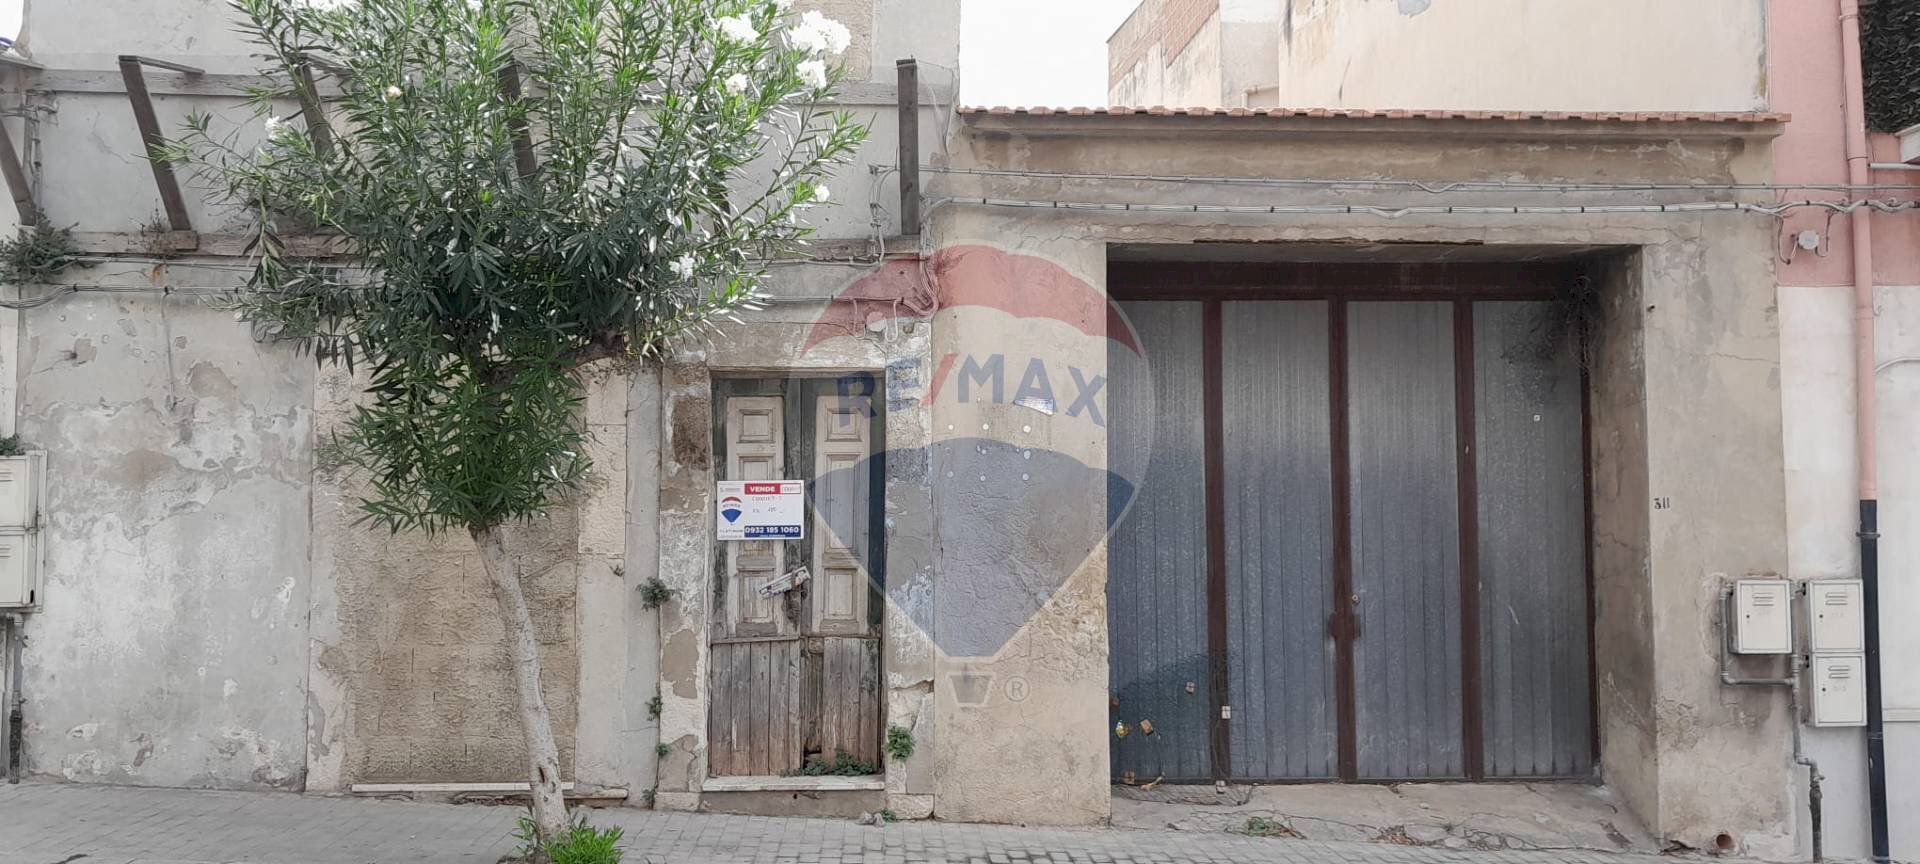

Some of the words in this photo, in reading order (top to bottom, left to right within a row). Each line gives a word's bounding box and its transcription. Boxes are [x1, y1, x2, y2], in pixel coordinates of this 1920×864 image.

[744, 526, 764, 534] 0932
[766, 526, 779, 534] 185
[780, 526, 800, 534] 1060
